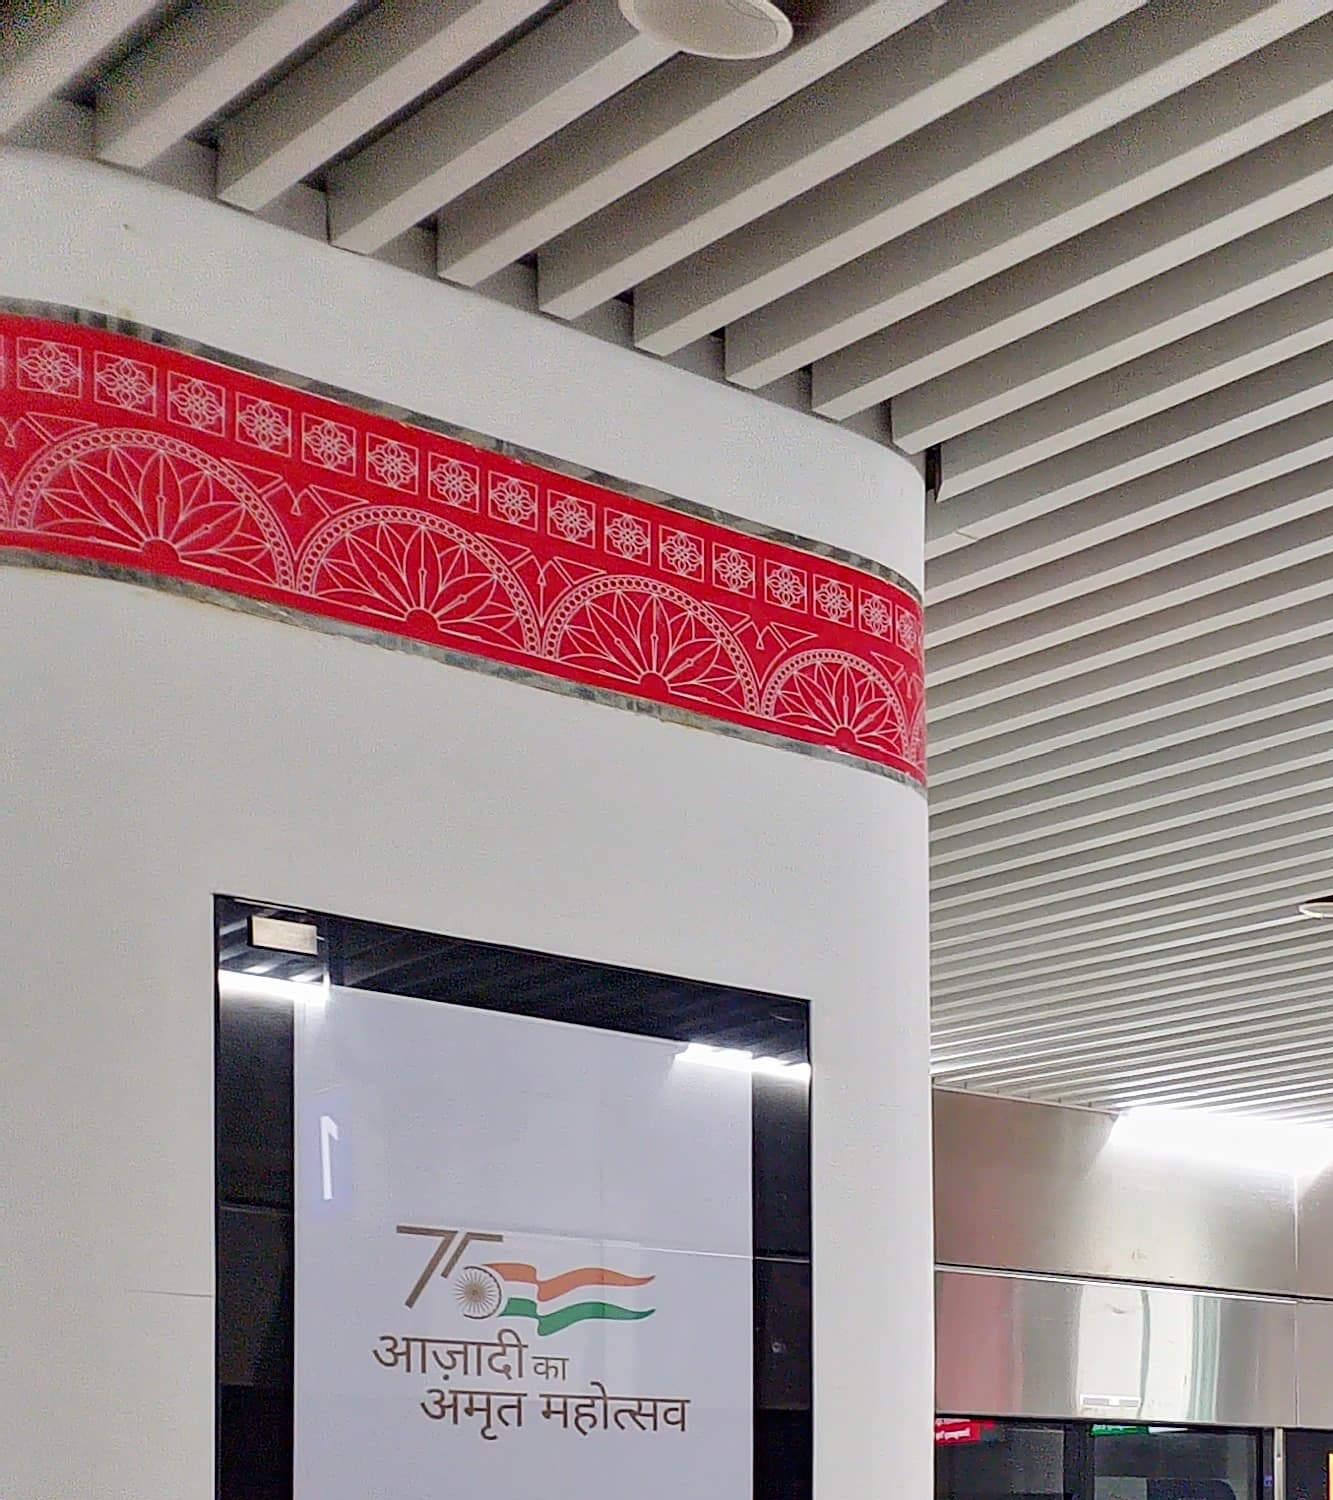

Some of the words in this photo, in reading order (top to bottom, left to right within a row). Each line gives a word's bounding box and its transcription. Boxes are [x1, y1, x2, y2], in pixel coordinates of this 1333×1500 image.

[373, 1328, 528, 1381] आज़ादी
[531, 1355, 570, 1381] का
[420, 1388, 528, 1440] अमृत
[539, 1381, 692, 1436] महोत्सव
